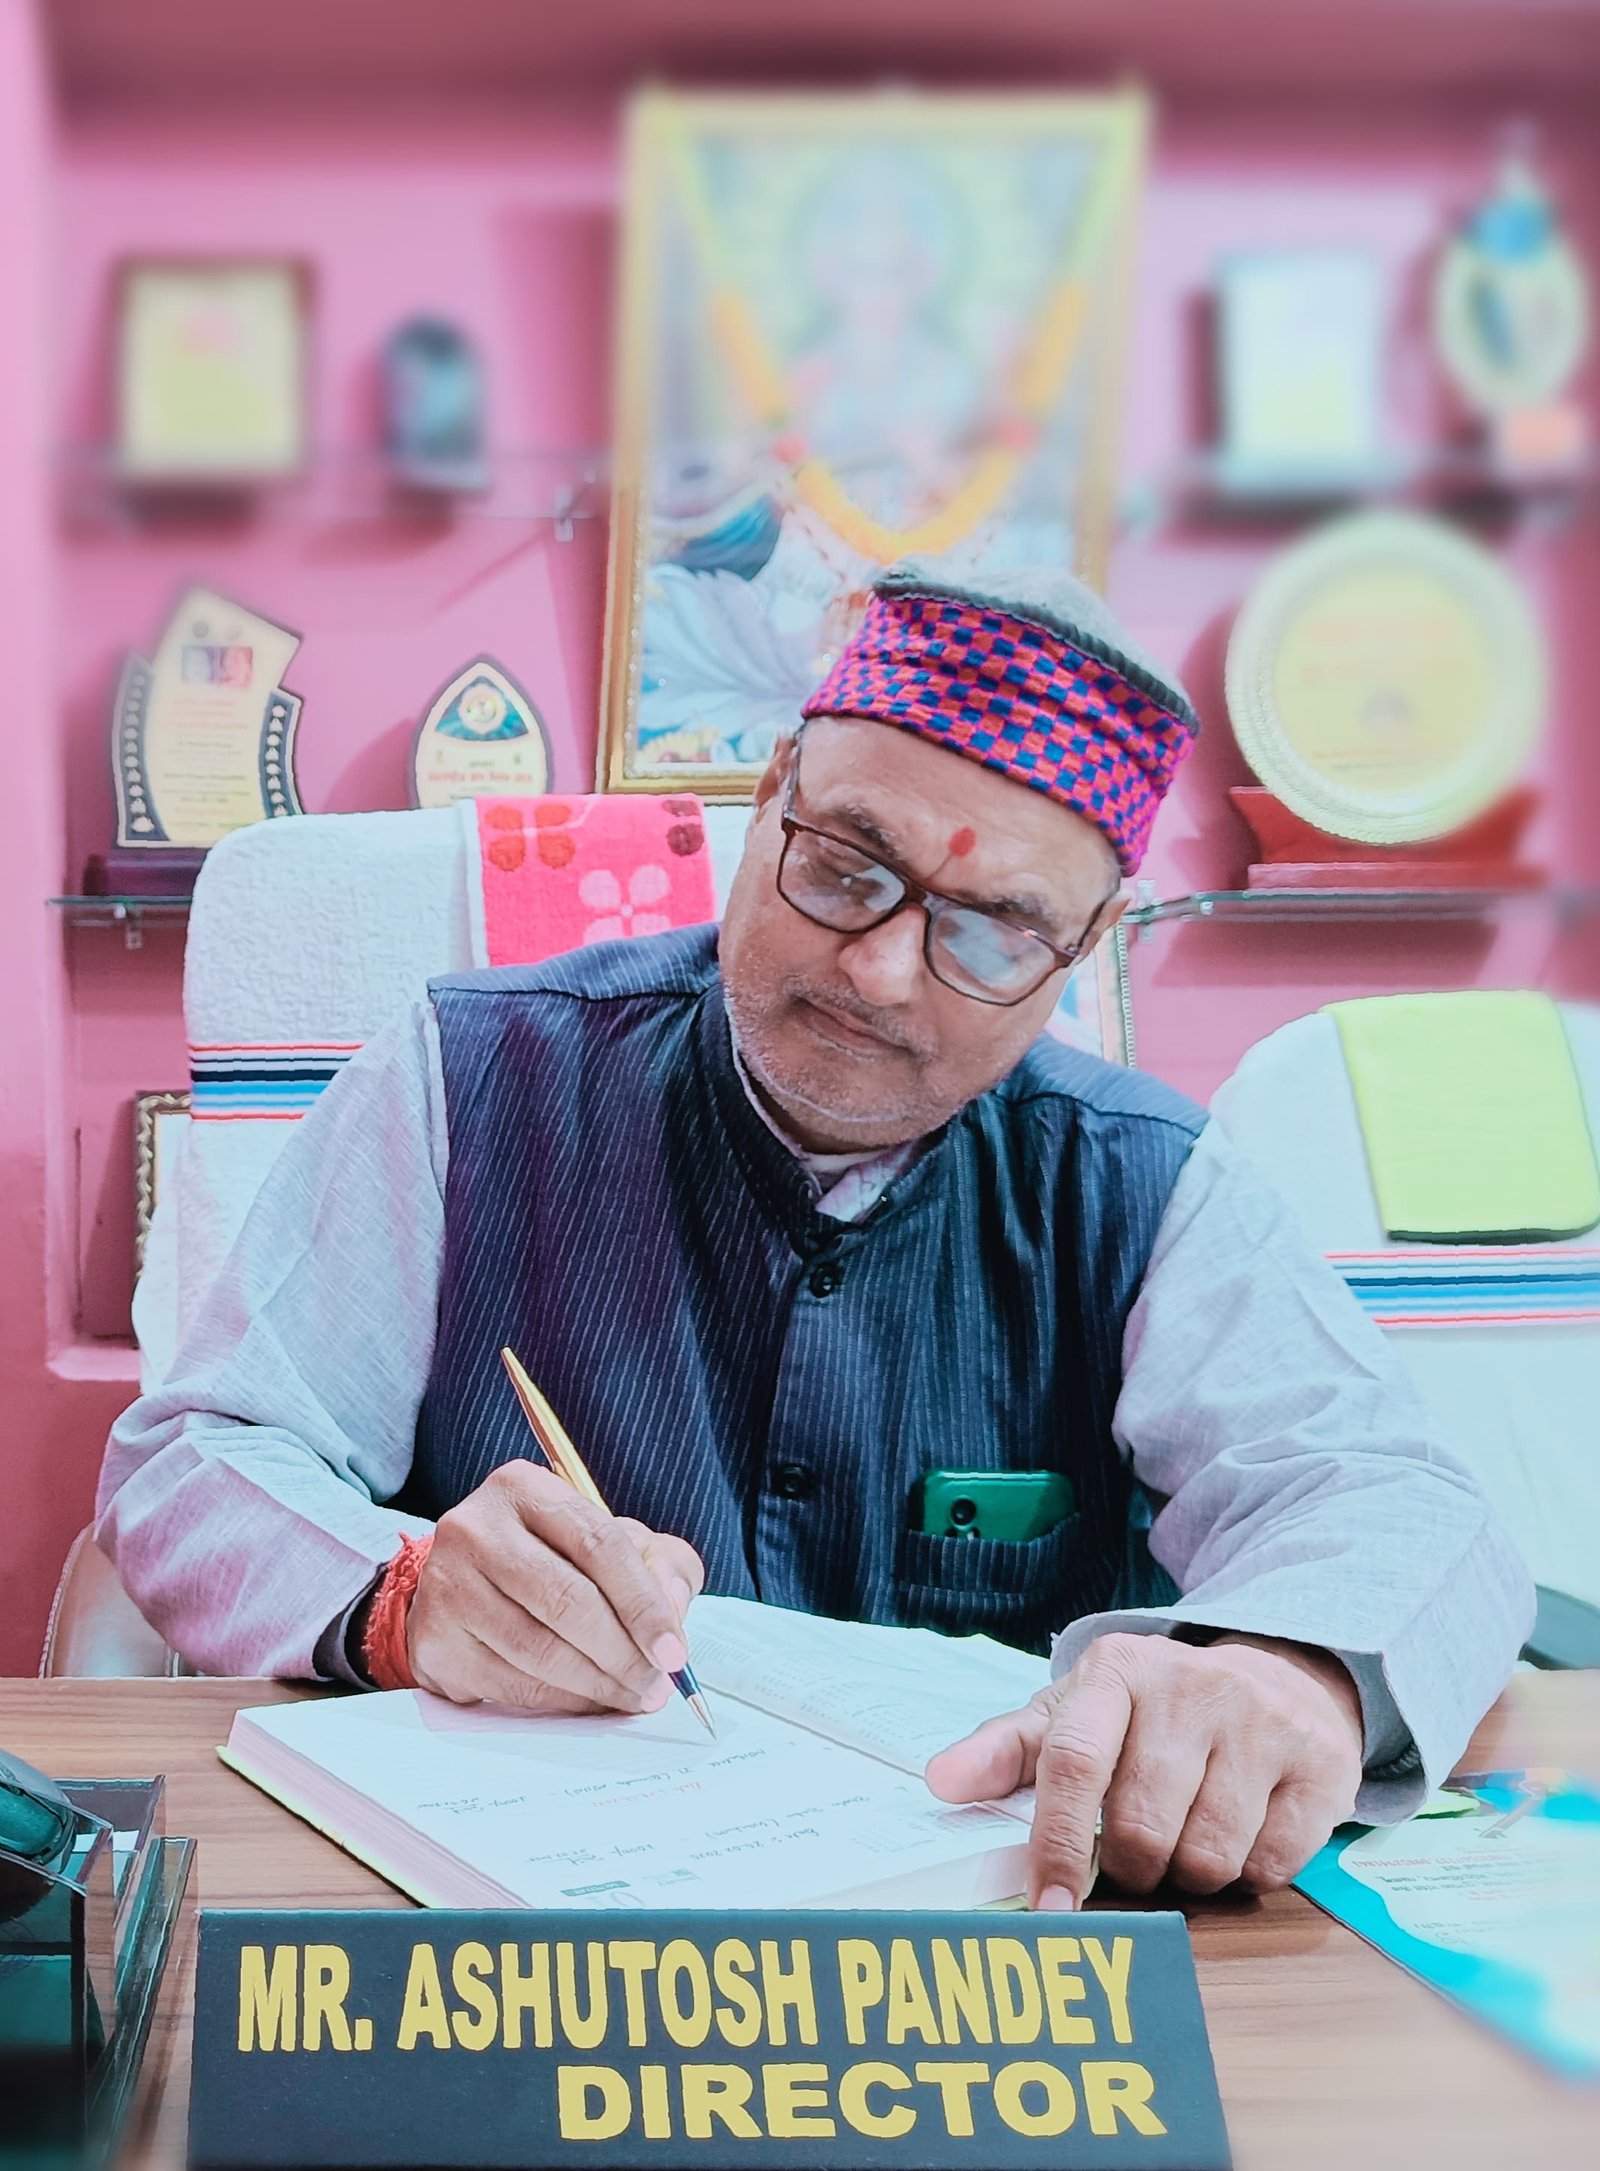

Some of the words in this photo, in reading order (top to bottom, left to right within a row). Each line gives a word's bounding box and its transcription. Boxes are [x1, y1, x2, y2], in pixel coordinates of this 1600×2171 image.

[237, 1943, 373, 2052] MR.
[397, 1939, 819, 2051] ASHUTOSH
[837, 1937, 1133, 2045] PANDEY
[557, 2061, 1165, 2141] DIRECTOR
